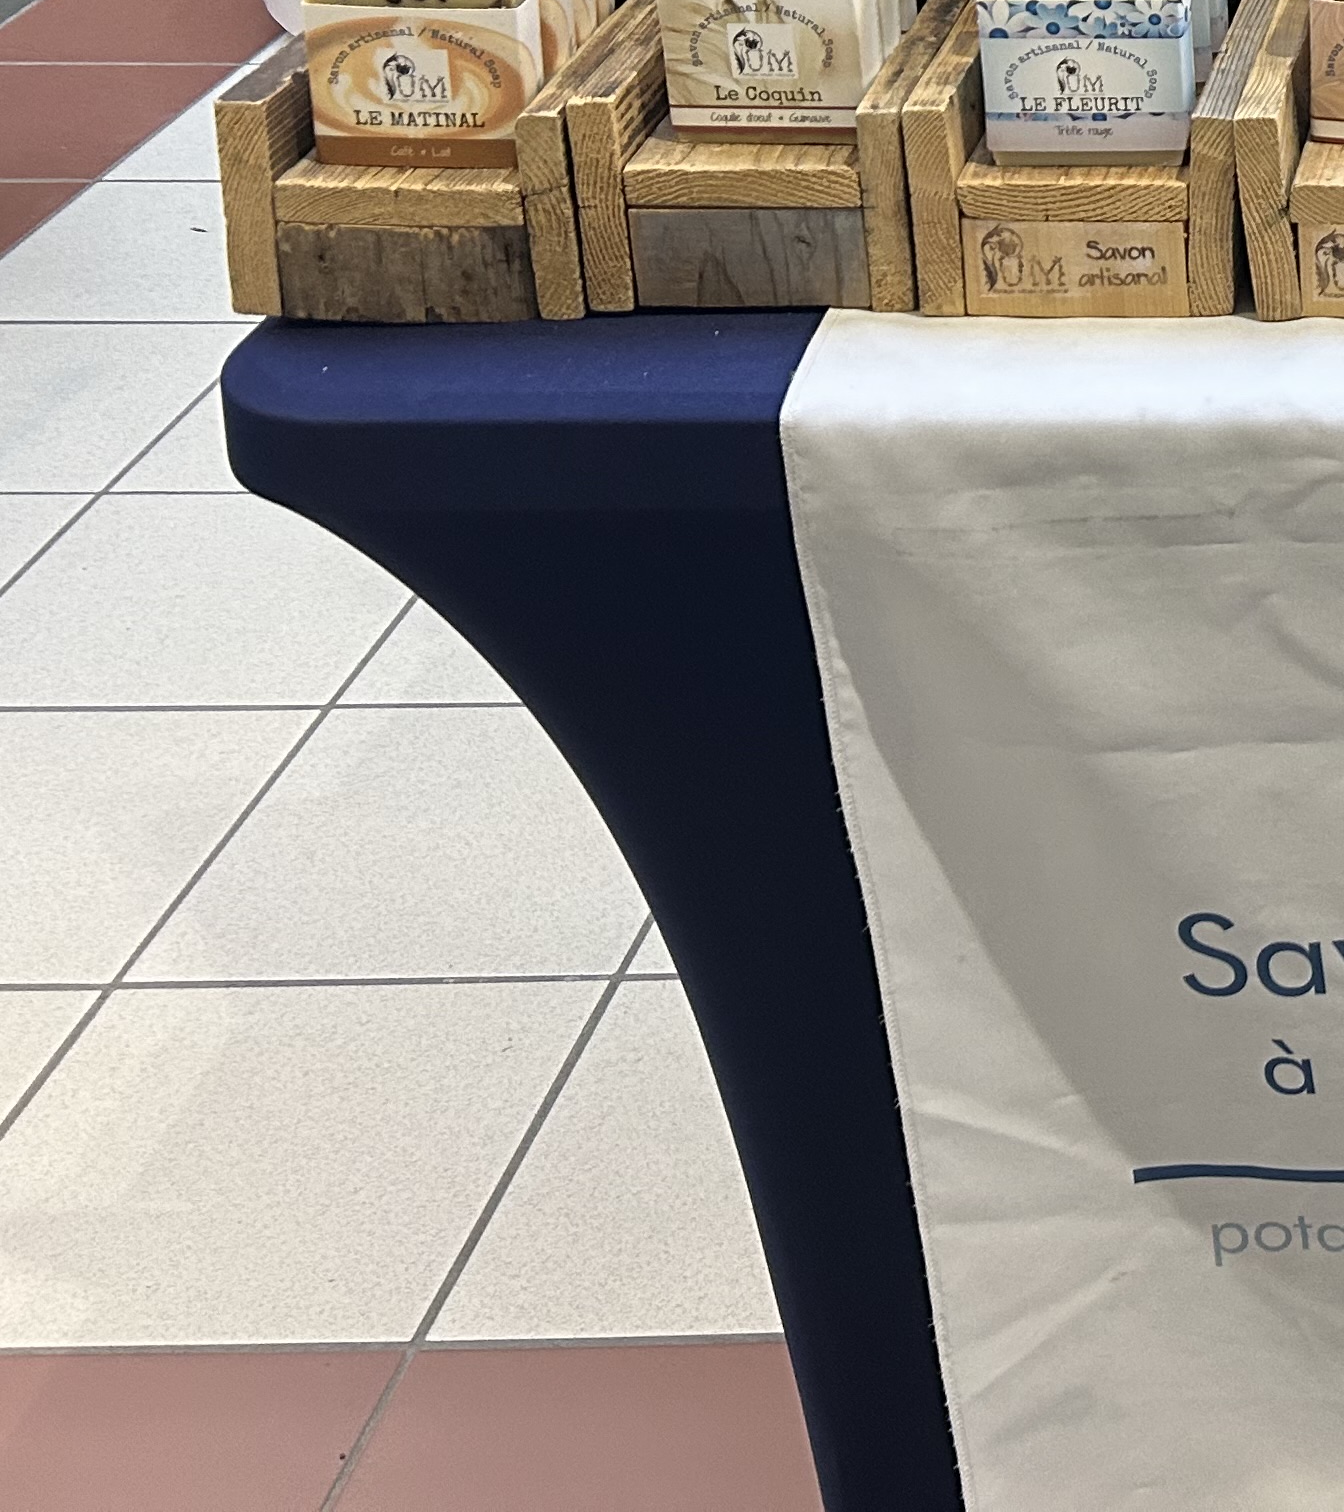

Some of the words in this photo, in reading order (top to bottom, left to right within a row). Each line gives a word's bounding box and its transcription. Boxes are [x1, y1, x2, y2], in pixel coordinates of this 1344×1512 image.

[1018, 40, 1082, 64] artisanal
[1098, 41, 1148, 69] Natural
[715, 86, 739, 101] Le
[746, 86, 822, 105] Coquin
[1020, 97, 1046, 111] LE
[1054, 96, 1144, 112] FLEURIT
[354, 109, 382, 126] LE
[390, 110, 485, 128] MATINAL
[1086, 240, 1155, 260] Savon
[1079, 266, 1168, 288] artisanal
[1264, 1041, 1316, 1097] à
